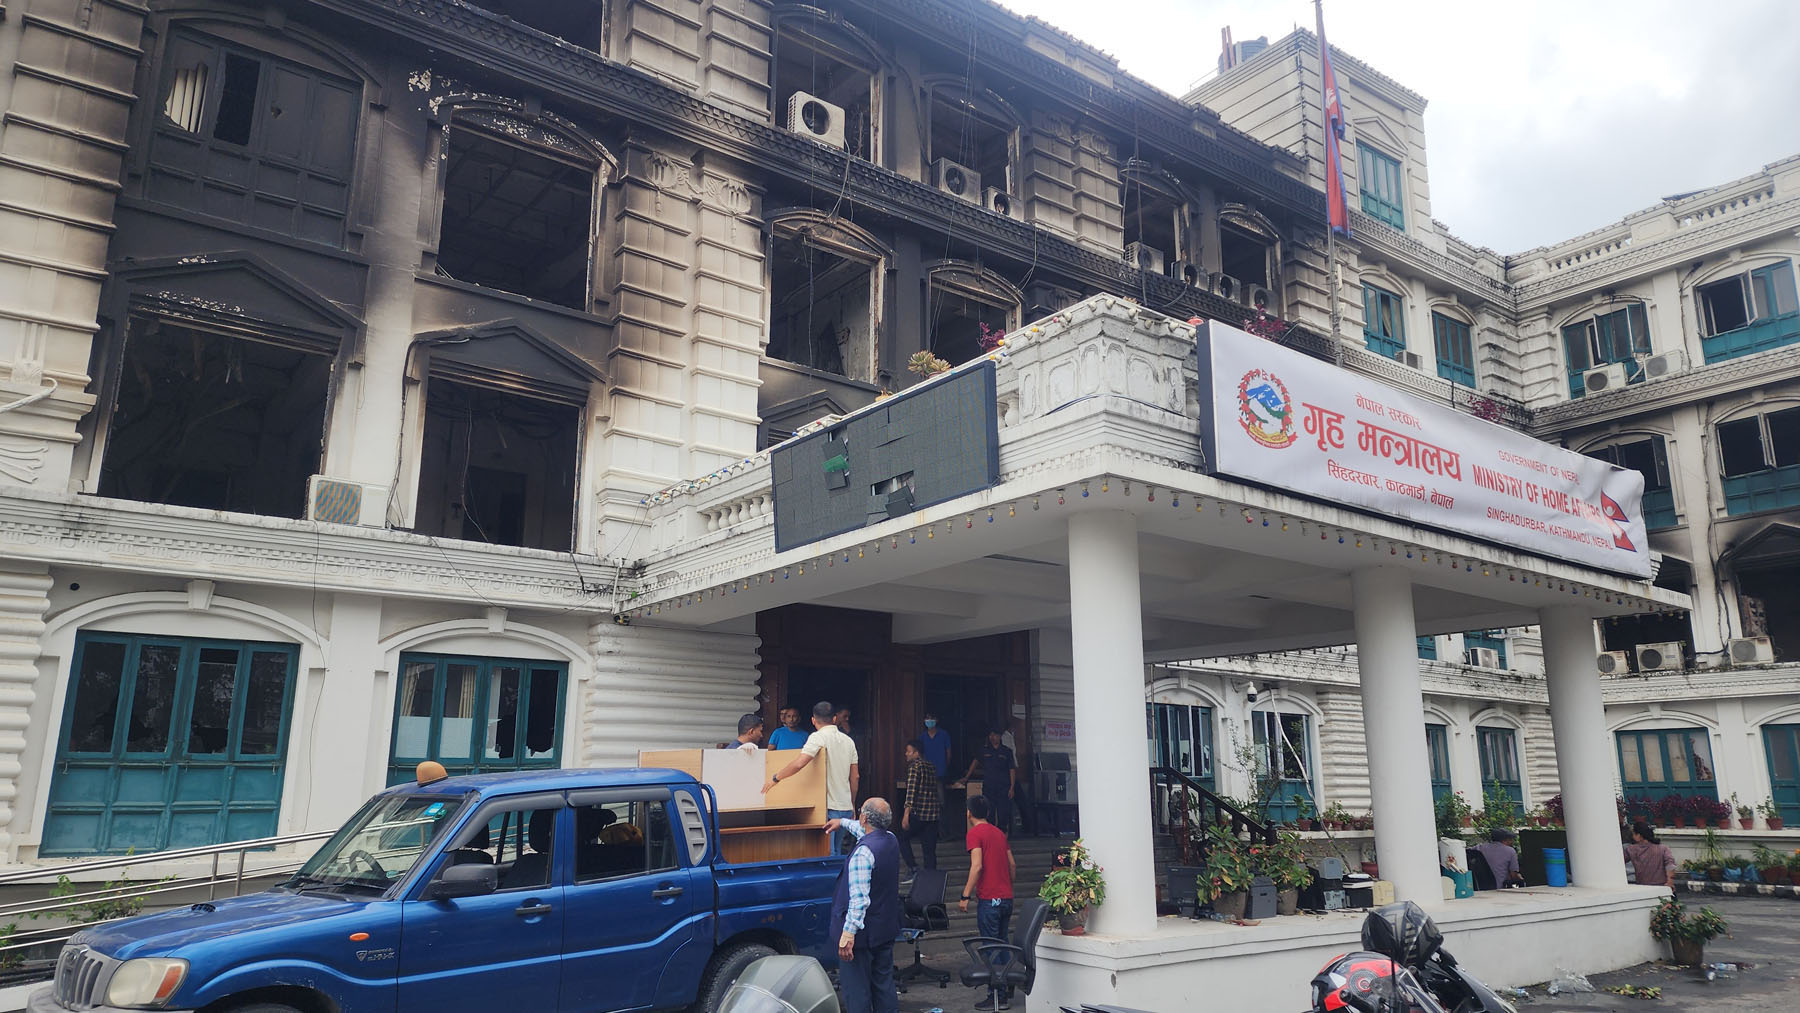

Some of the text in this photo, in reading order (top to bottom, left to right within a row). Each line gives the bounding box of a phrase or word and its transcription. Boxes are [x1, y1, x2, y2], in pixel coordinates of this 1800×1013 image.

[1355, 392, 1422, 430] नेपाल सरकार
[1302, 402, 1462, 482] गृह मन्त्रालय
[1498, 450, 1548, 474] GOVERNMENT
[1430, 487, 1454, 510] नेपाल
[1472, 464, 1523, 499] MINISTRY
[1526, 481, 1539, 504] OF
[1541, 486, 1570, 514] HOME
[1486, 506, 1548, 534] SINGHADURBAR,
[1592, 535, 1614, 550] NEPAL
